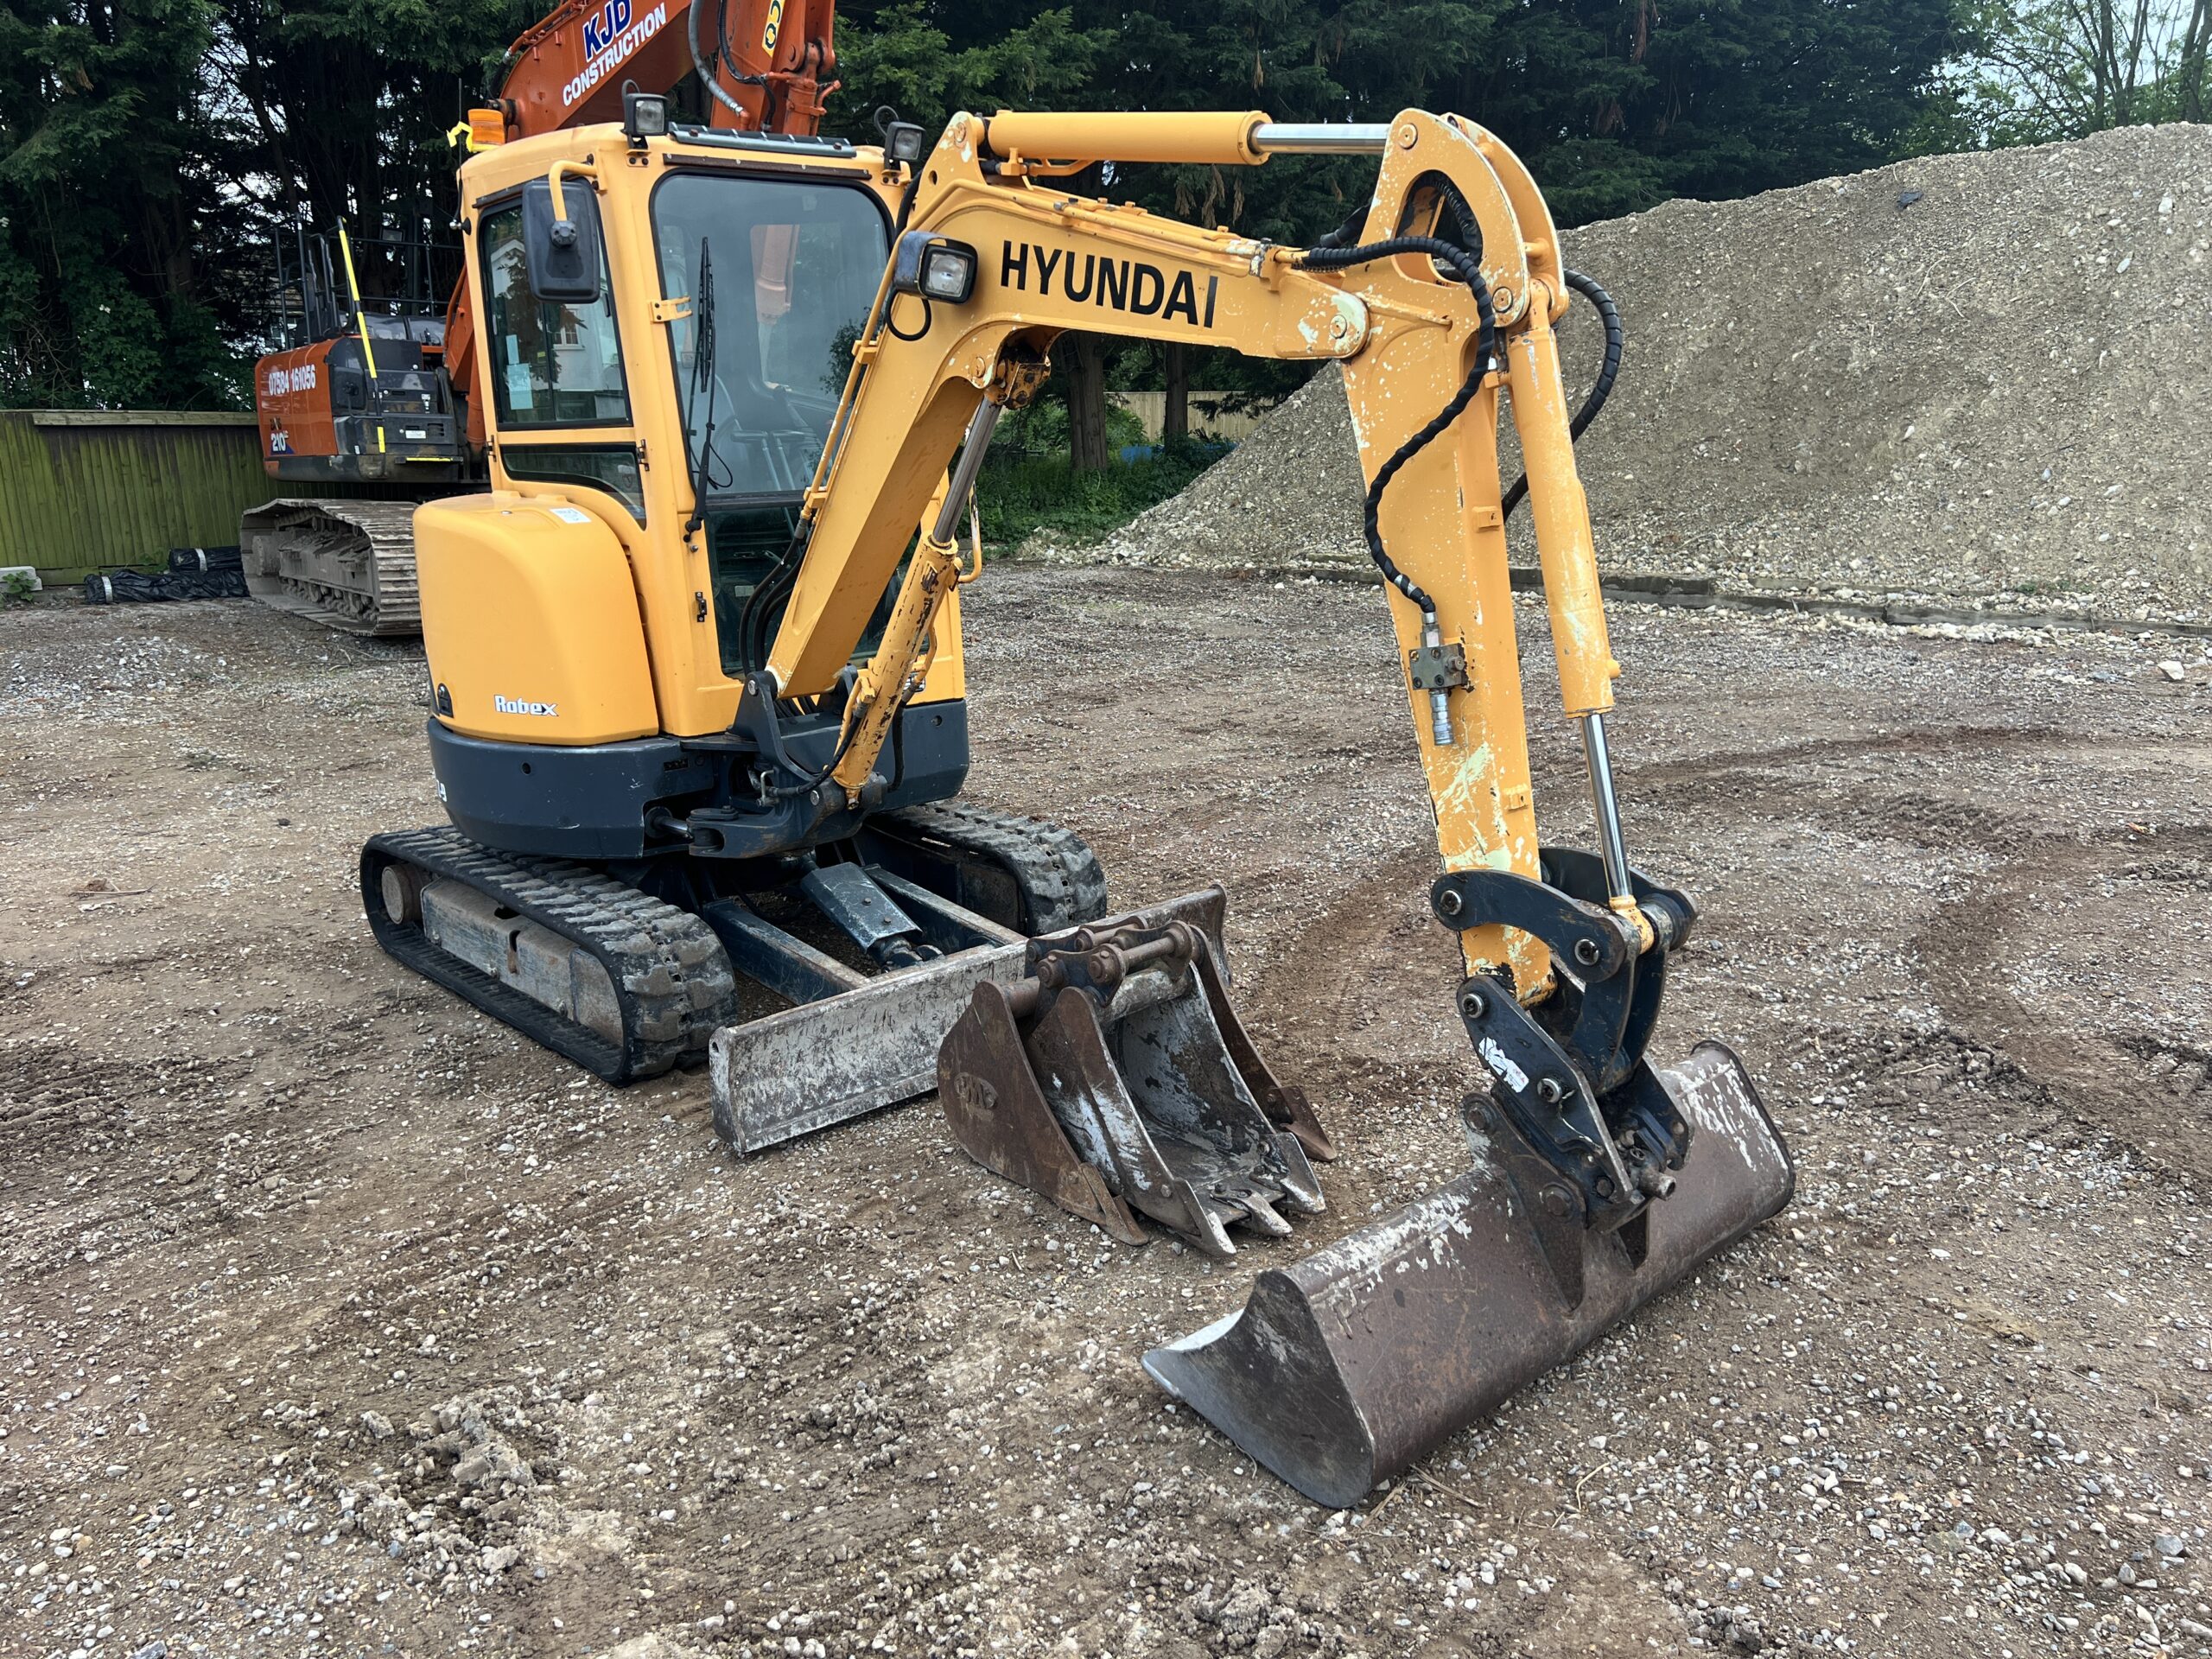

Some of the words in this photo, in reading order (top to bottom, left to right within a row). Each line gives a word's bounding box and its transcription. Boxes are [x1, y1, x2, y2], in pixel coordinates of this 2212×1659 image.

[563, 2, 666, 106] CONSTRUCTION
[582, 0, 632, 62] KJD
[1001, 240, 1218, 328] HYUNDAI
[269, 369, 289, 396] 07584
[290, 364, 316, 391] 161056
[494, 695, 559, 716] Robex
